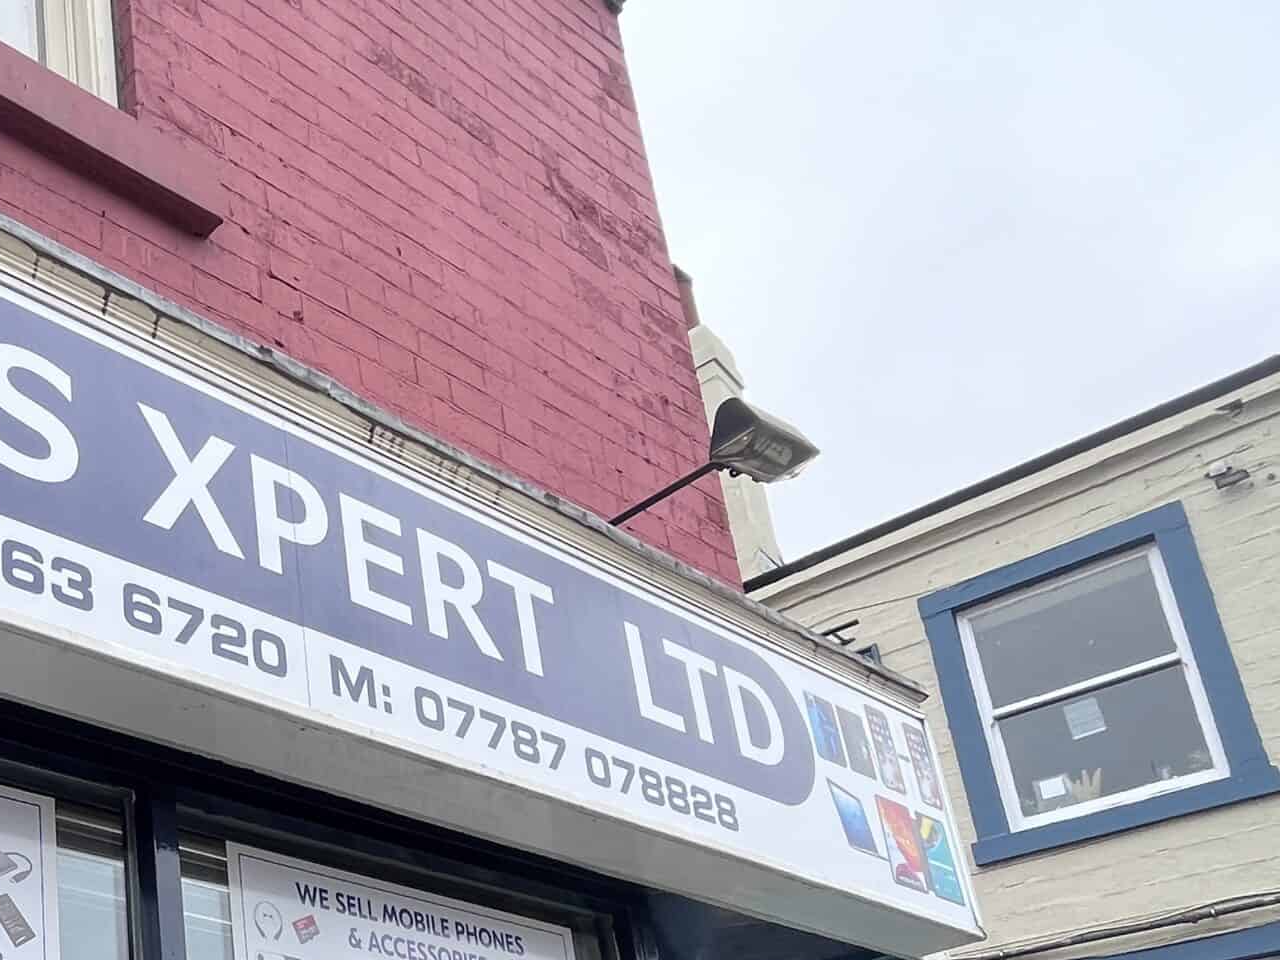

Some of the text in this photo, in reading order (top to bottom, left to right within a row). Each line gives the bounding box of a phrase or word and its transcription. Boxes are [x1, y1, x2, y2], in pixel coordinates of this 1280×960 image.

[136, 401, 555, 678] XPERT
[622, 620, 785, 767] LTD
[122, 582, 288, 678] 6720
[330, 653, 394, 715] M:
[414, 685, 567, 771] 07787
[584, 745, 740, 832] 078828
[295, 882, 525, 956] WE SELL MOBILE PHONES
[348, 927, 363, 950] &
